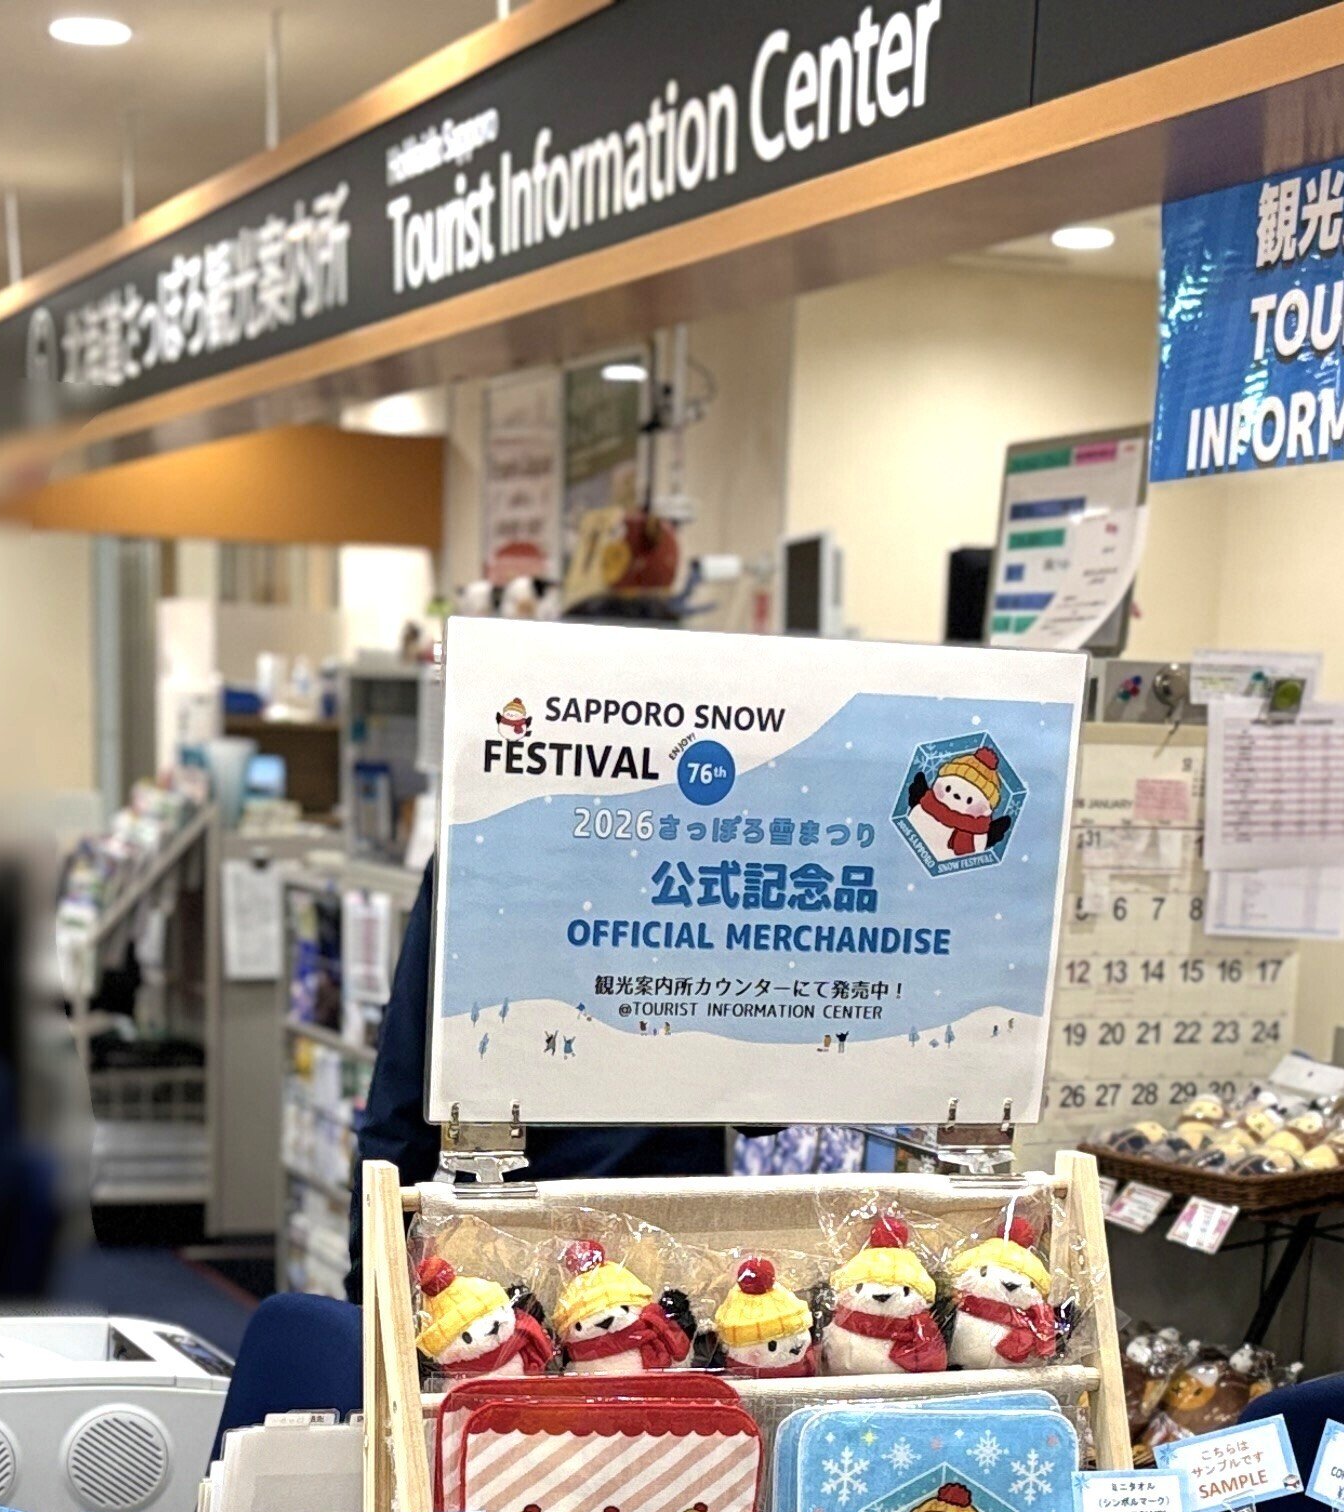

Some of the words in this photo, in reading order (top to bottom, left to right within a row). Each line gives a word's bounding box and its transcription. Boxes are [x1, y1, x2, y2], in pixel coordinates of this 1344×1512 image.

[387, 172, 496, 294] Tourist
[500, 80, 737, 256] Information
[750, 0, 942, 162] Center
[544, 696, 686, 728] SAPPORO
[693, 704, 787, 734] SNOW
[482, 739, 660, 781] FESTIVAL
[685, 762, 728, 785] 76th
[649, 859, 880, 914] 公式記念品
[1112, 896, 1128, 922] 6
[1152, 896, 1167, 922] 7
[566, 917, 716, 950] OFFICIAL
[725, 922, 952, 957] MERCHANDISE
[1065, 959, 1091, 984] 12
[1103, 959, 1128, 984] 13
[1140, 959, 1165, 983] 14
[1179, 959, 1205, 983] 15
[1217, 959, 1243, 983] 16
[1256, 959, 1283, 982] 17
[617, 1001, 697, 1021] @TOURIST
[706, 1002, 816, 1020] INFORMATION
[822, 1003, 884, 1021] CENTER
[1062, 1022, 1087, 1046] 19
[1098, 1021, 1126, 1045] 20
[1136, 1021, 1162, 1044] 21
[1173, 1021, 1202, 1044] 22
[1211, 1020, 1240, 1044] 23
[1250, 1020, 1281, 1044] 24
[1059, 1084, 1086, 1108] 26
[1095, 1083, 1122, 1106] 27
[1131, 1082, 1158, 1105] 28
[1200, 1439, 1251, 1462] こちらは
[1110, 1481, 1156, 1492] ミニタオル
[1198, 1468, 1270, 1500] SAMPLE
